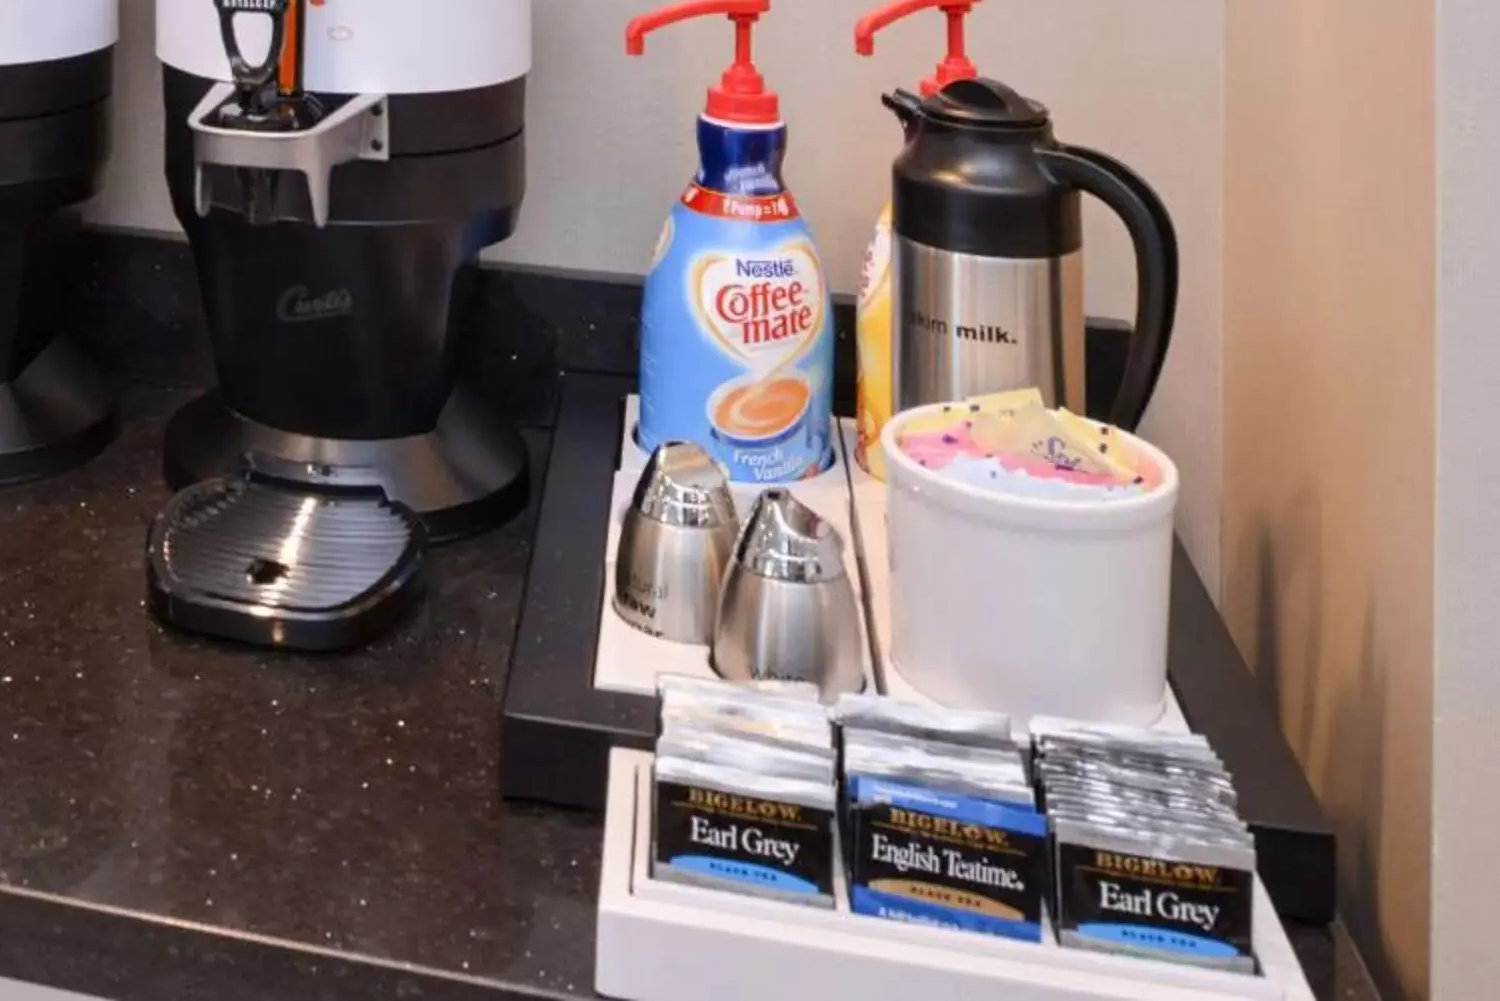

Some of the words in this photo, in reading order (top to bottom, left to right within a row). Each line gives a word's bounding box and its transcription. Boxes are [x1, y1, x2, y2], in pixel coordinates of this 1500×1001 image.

[736, 258, 794, 278] Nestlé
[715, 280, 803, 324] Coffee
[743, 303, 812, 344] mate
[956, 325, 1018, 345] milk.
[688, 787, 799, 820] BIGELOW
[690, 815, 737, 852] Earl
[741, 828, 801, 866] Grey
[889, 807, 1008, 844] BIGELOW
[871, 833, 940, 874] English
[1098, 880, 1152, 916] Earl
[1155, 891, 1221, 933] Grey
